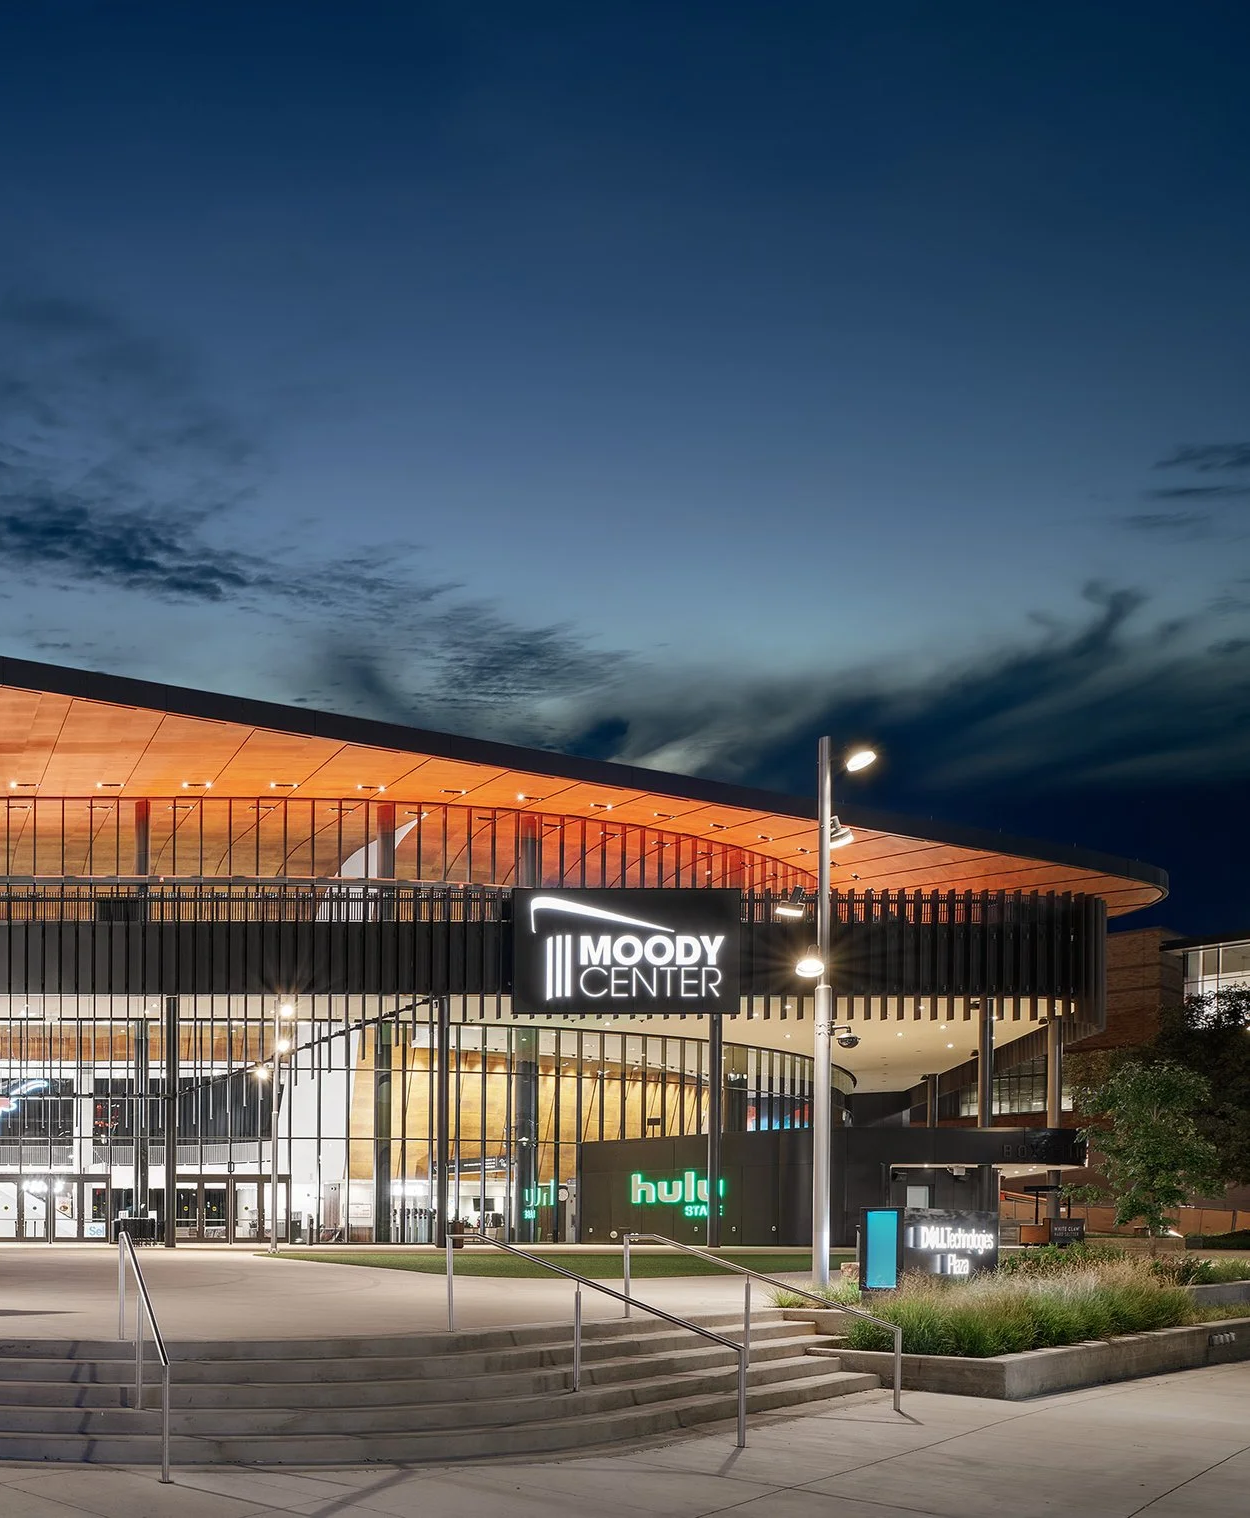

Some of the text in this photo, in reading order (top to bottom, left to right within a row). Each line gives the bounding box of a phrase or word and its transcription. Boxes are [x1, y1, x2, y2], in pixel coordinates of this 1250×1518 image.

[580, 935, 725, 966] MOODY
[579, 966, 723, 998] CENTER
[631, 1171, 723, 1203] hulu
[946, 1226, 994, 1255] Technologies
[948, 1253, 969, 1275] Plaza
